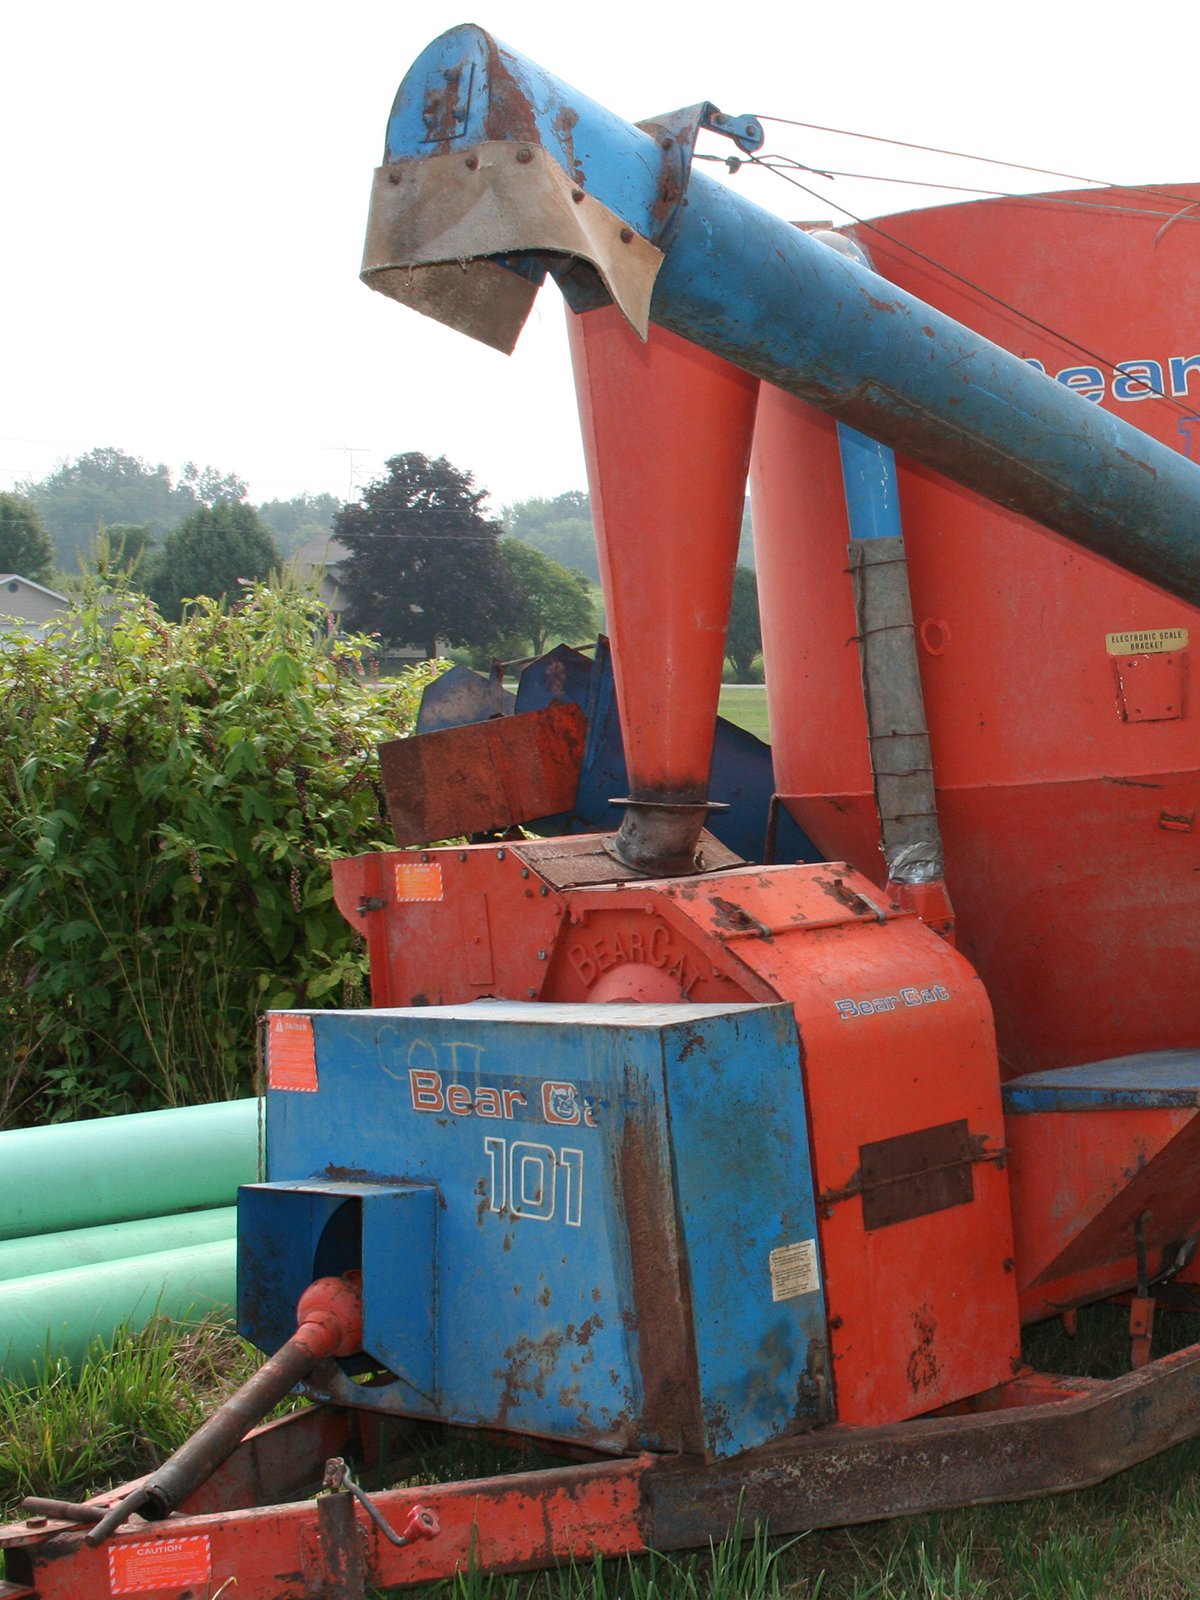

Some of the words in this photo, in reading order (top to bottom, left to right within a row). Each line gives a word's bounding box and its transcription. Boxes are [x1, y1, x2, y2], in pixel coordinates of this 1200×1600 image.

[1111, 632, 1157, 644] ELECTRONIC
[1159, 630, 1182, 640] SCALE
[1130, 641, 1164, 651] BRACKET
[834, 995, 900, 1019] Bear
[899, 984, 950, 1007] Cat
[408, 1067, 528, 1121] Bear
[484, 1135, 584, 1228] 101
[136, 1544, 182, 1556] CAUTION
